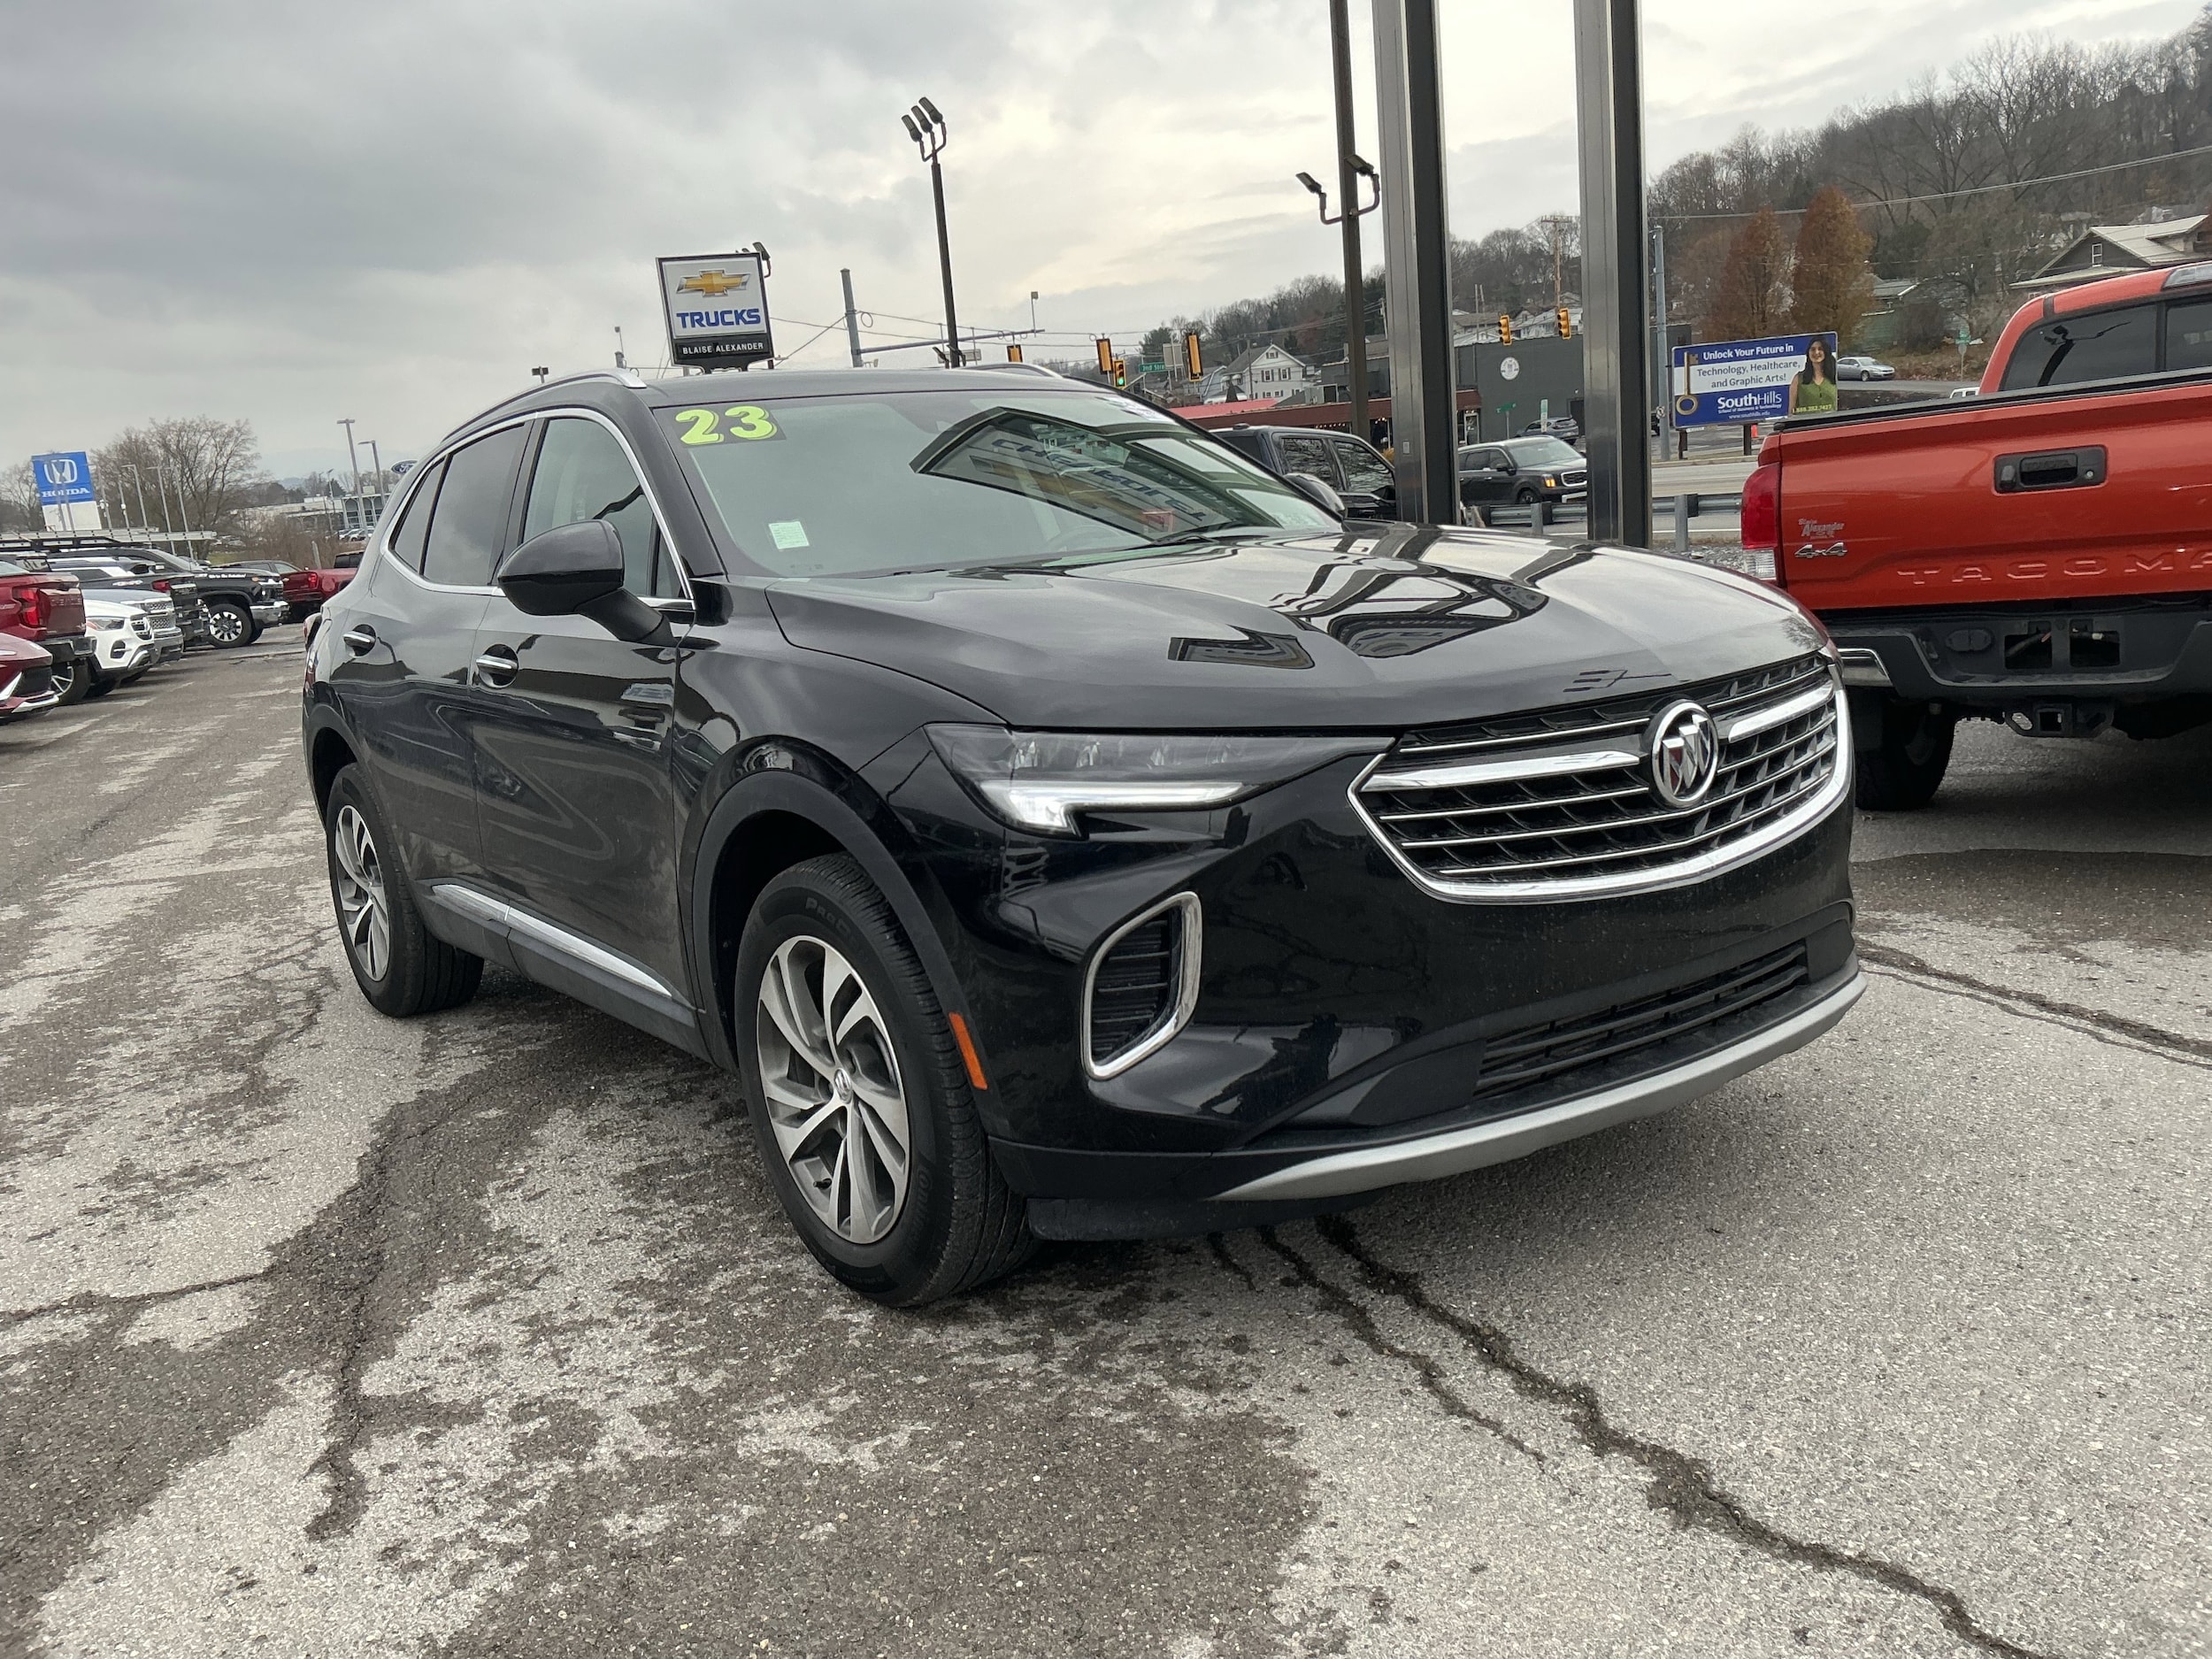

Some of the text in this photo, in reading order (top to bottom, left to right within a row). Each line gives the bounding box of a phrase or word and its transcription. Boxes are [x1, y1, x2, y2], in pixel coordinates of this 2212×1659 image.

[676, 308, 761, 328] TRUCKS
[682, 342, 764, 355] BLAISE ALEXANDER
[1702, 343, 1794, 361] Unlock Your Future in
[1697, 359, 1801, 378] Technology, Healthcare,
[1711, 373, 1787, 388] and Graphic Arts!
[675, 405, 778, 445] 23
